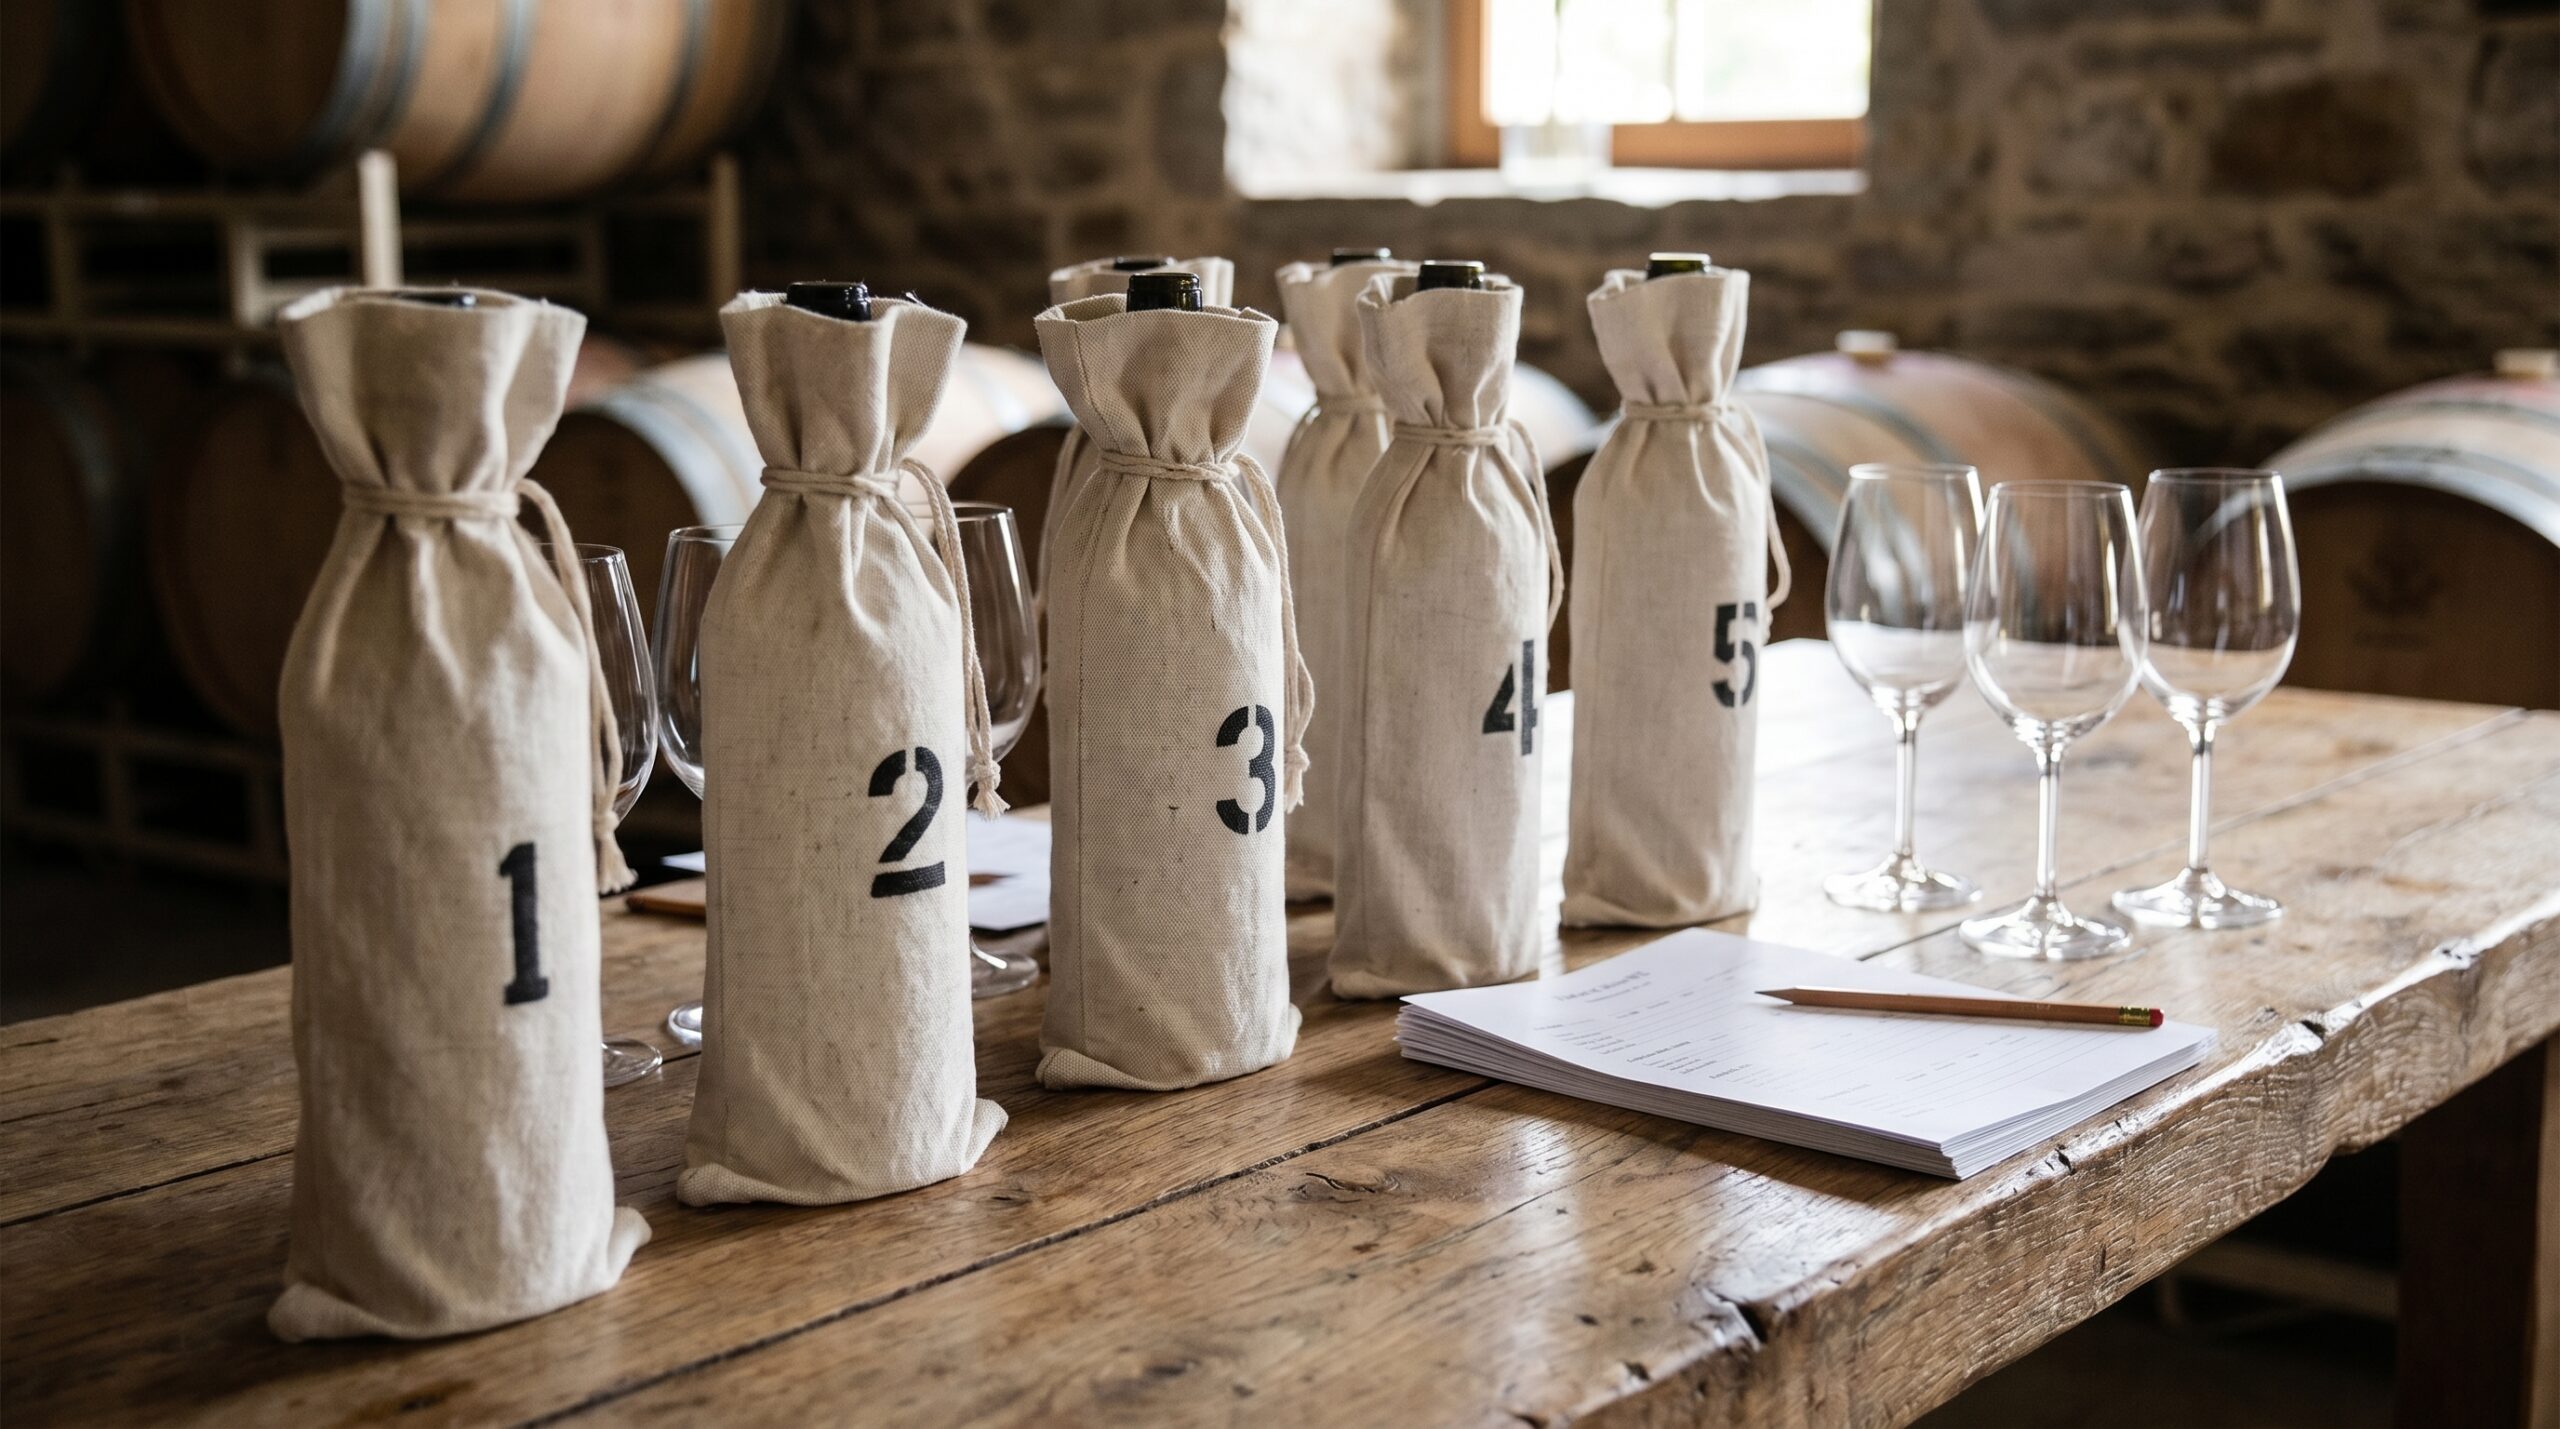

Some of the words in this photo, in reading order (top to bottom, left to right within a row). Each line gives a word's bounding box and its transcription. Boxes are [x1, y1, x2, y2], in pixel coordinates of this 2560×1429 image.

[1482, 638, 1537, 756] 4
[1711, 602, 1757, 708] 5
[868, 746, 945, 898] 2
[1216, 704, 1275, 835] 3
[498, 841, 548, 1006] 1
